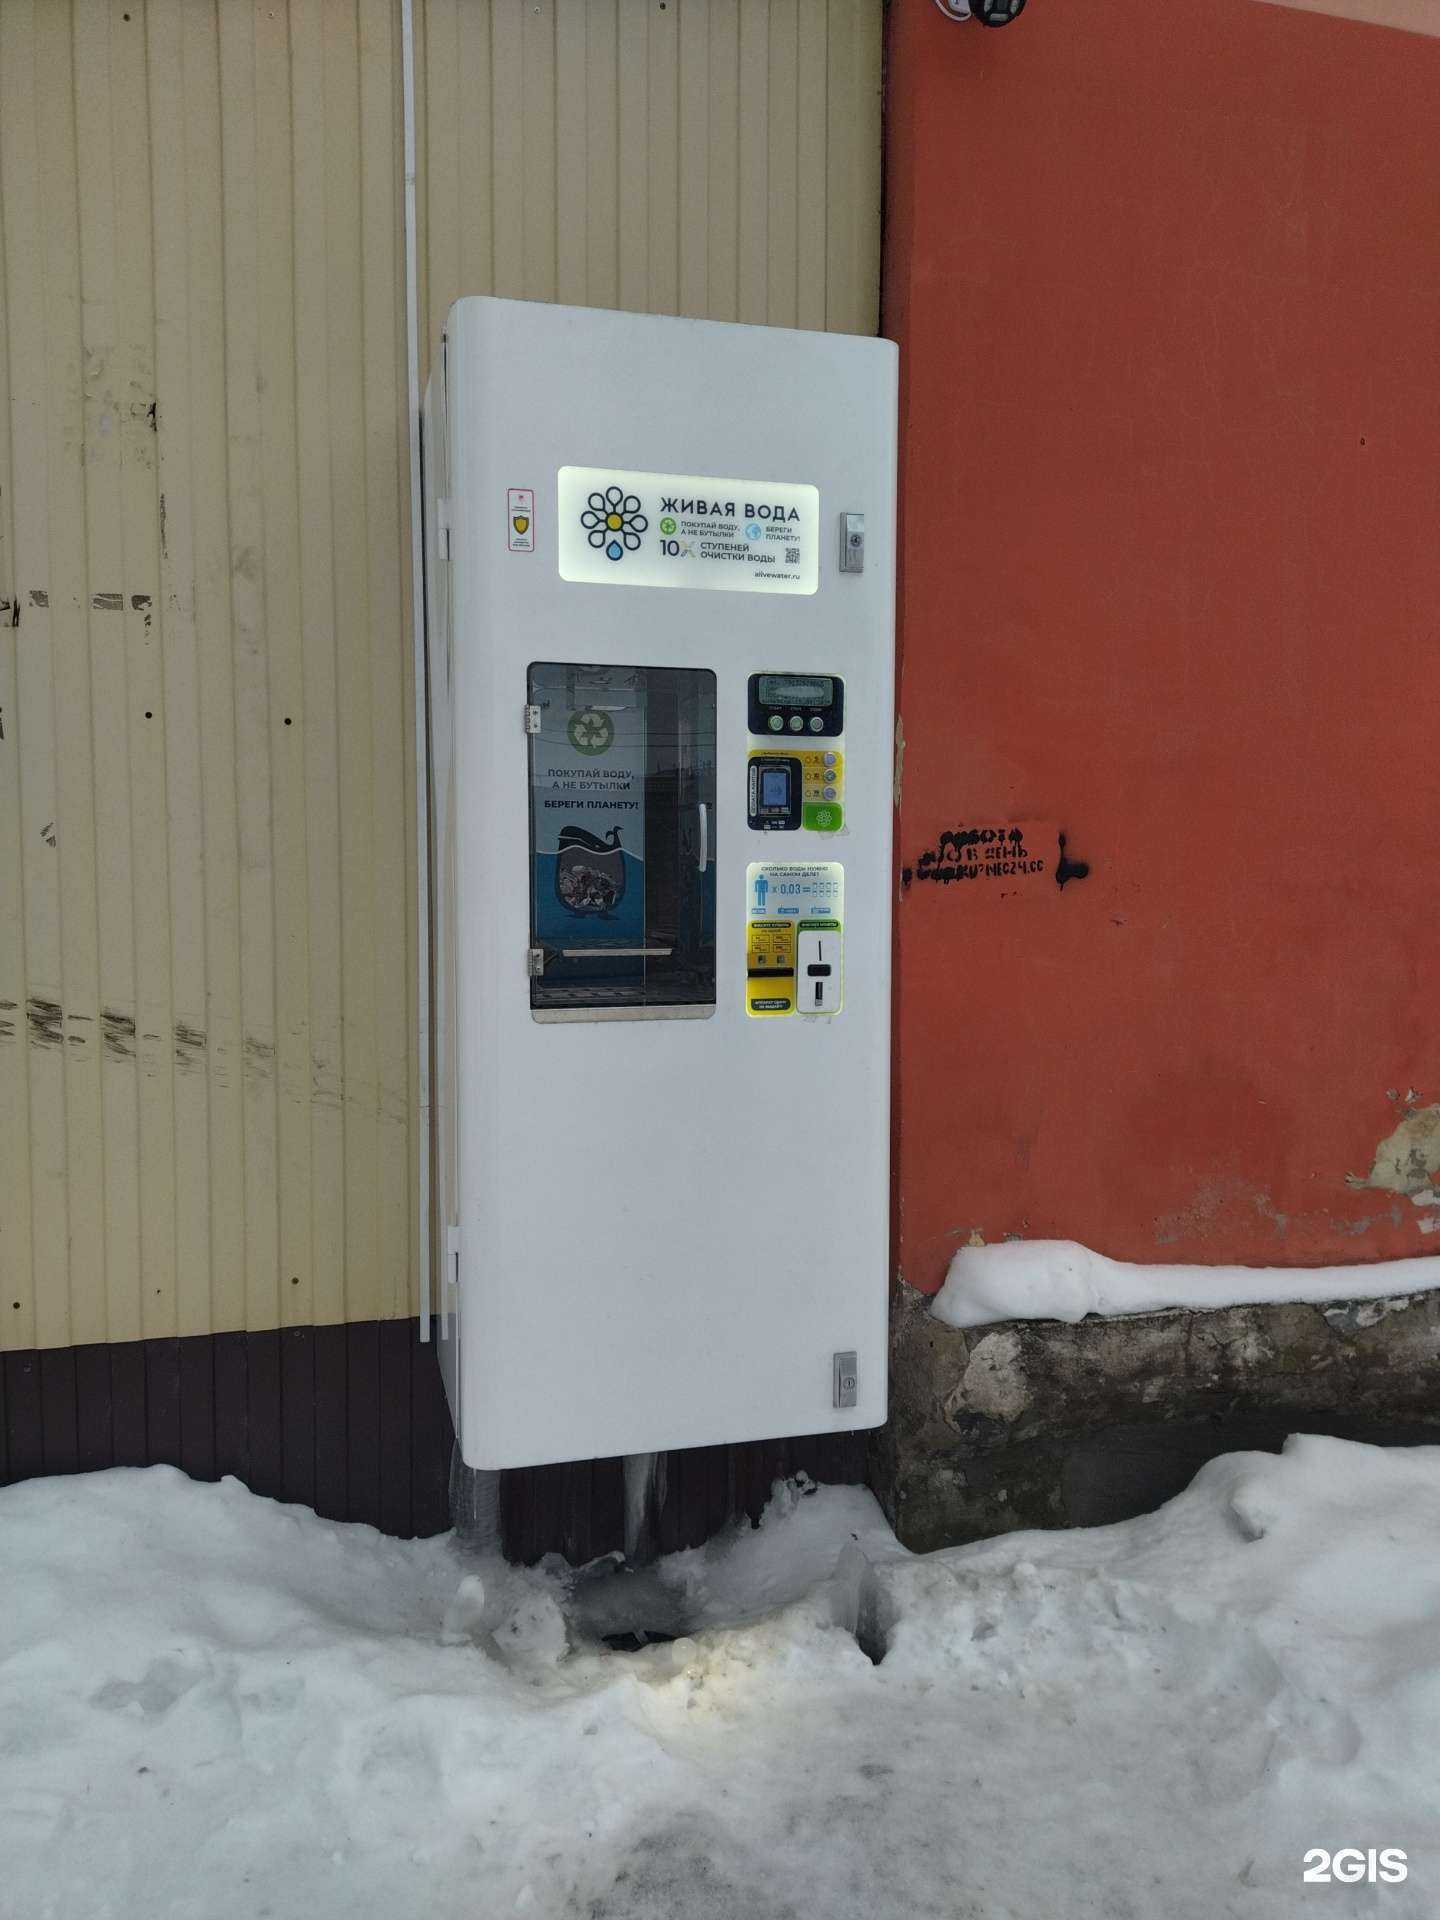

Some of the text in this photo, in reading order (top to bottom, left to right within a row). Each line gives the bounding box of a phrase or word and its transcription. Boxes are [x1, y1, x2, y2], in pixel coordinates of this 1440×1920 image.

[660, 496, 801, 523] ЖИВАЯ ВОДА
[681, 520, 717, 530] ПОКУПАЙ
[765, 526, 792, 534] БЕРЕГИ
[699, 529, 735, 538] БУТЫЛКИ
[659, 539, 680, 557] 10
[700, 541, 750, 552] СТУПЕНЕЙ
[700, 550, 776, 563] ОЧИСТКИ ВОДЫ
[754, 570, 801, 580] alivewater.ru
[547, 767, 635, 780] ПОКУПАЙ ВОДУ,
[552, 781, 631, 790] А НЕ БУТЫЛКИ
[544, 800, 640, 810] БЕРЕГИ ПЛАНЕТУ!
[780, 883, 801, 896] 0,03
